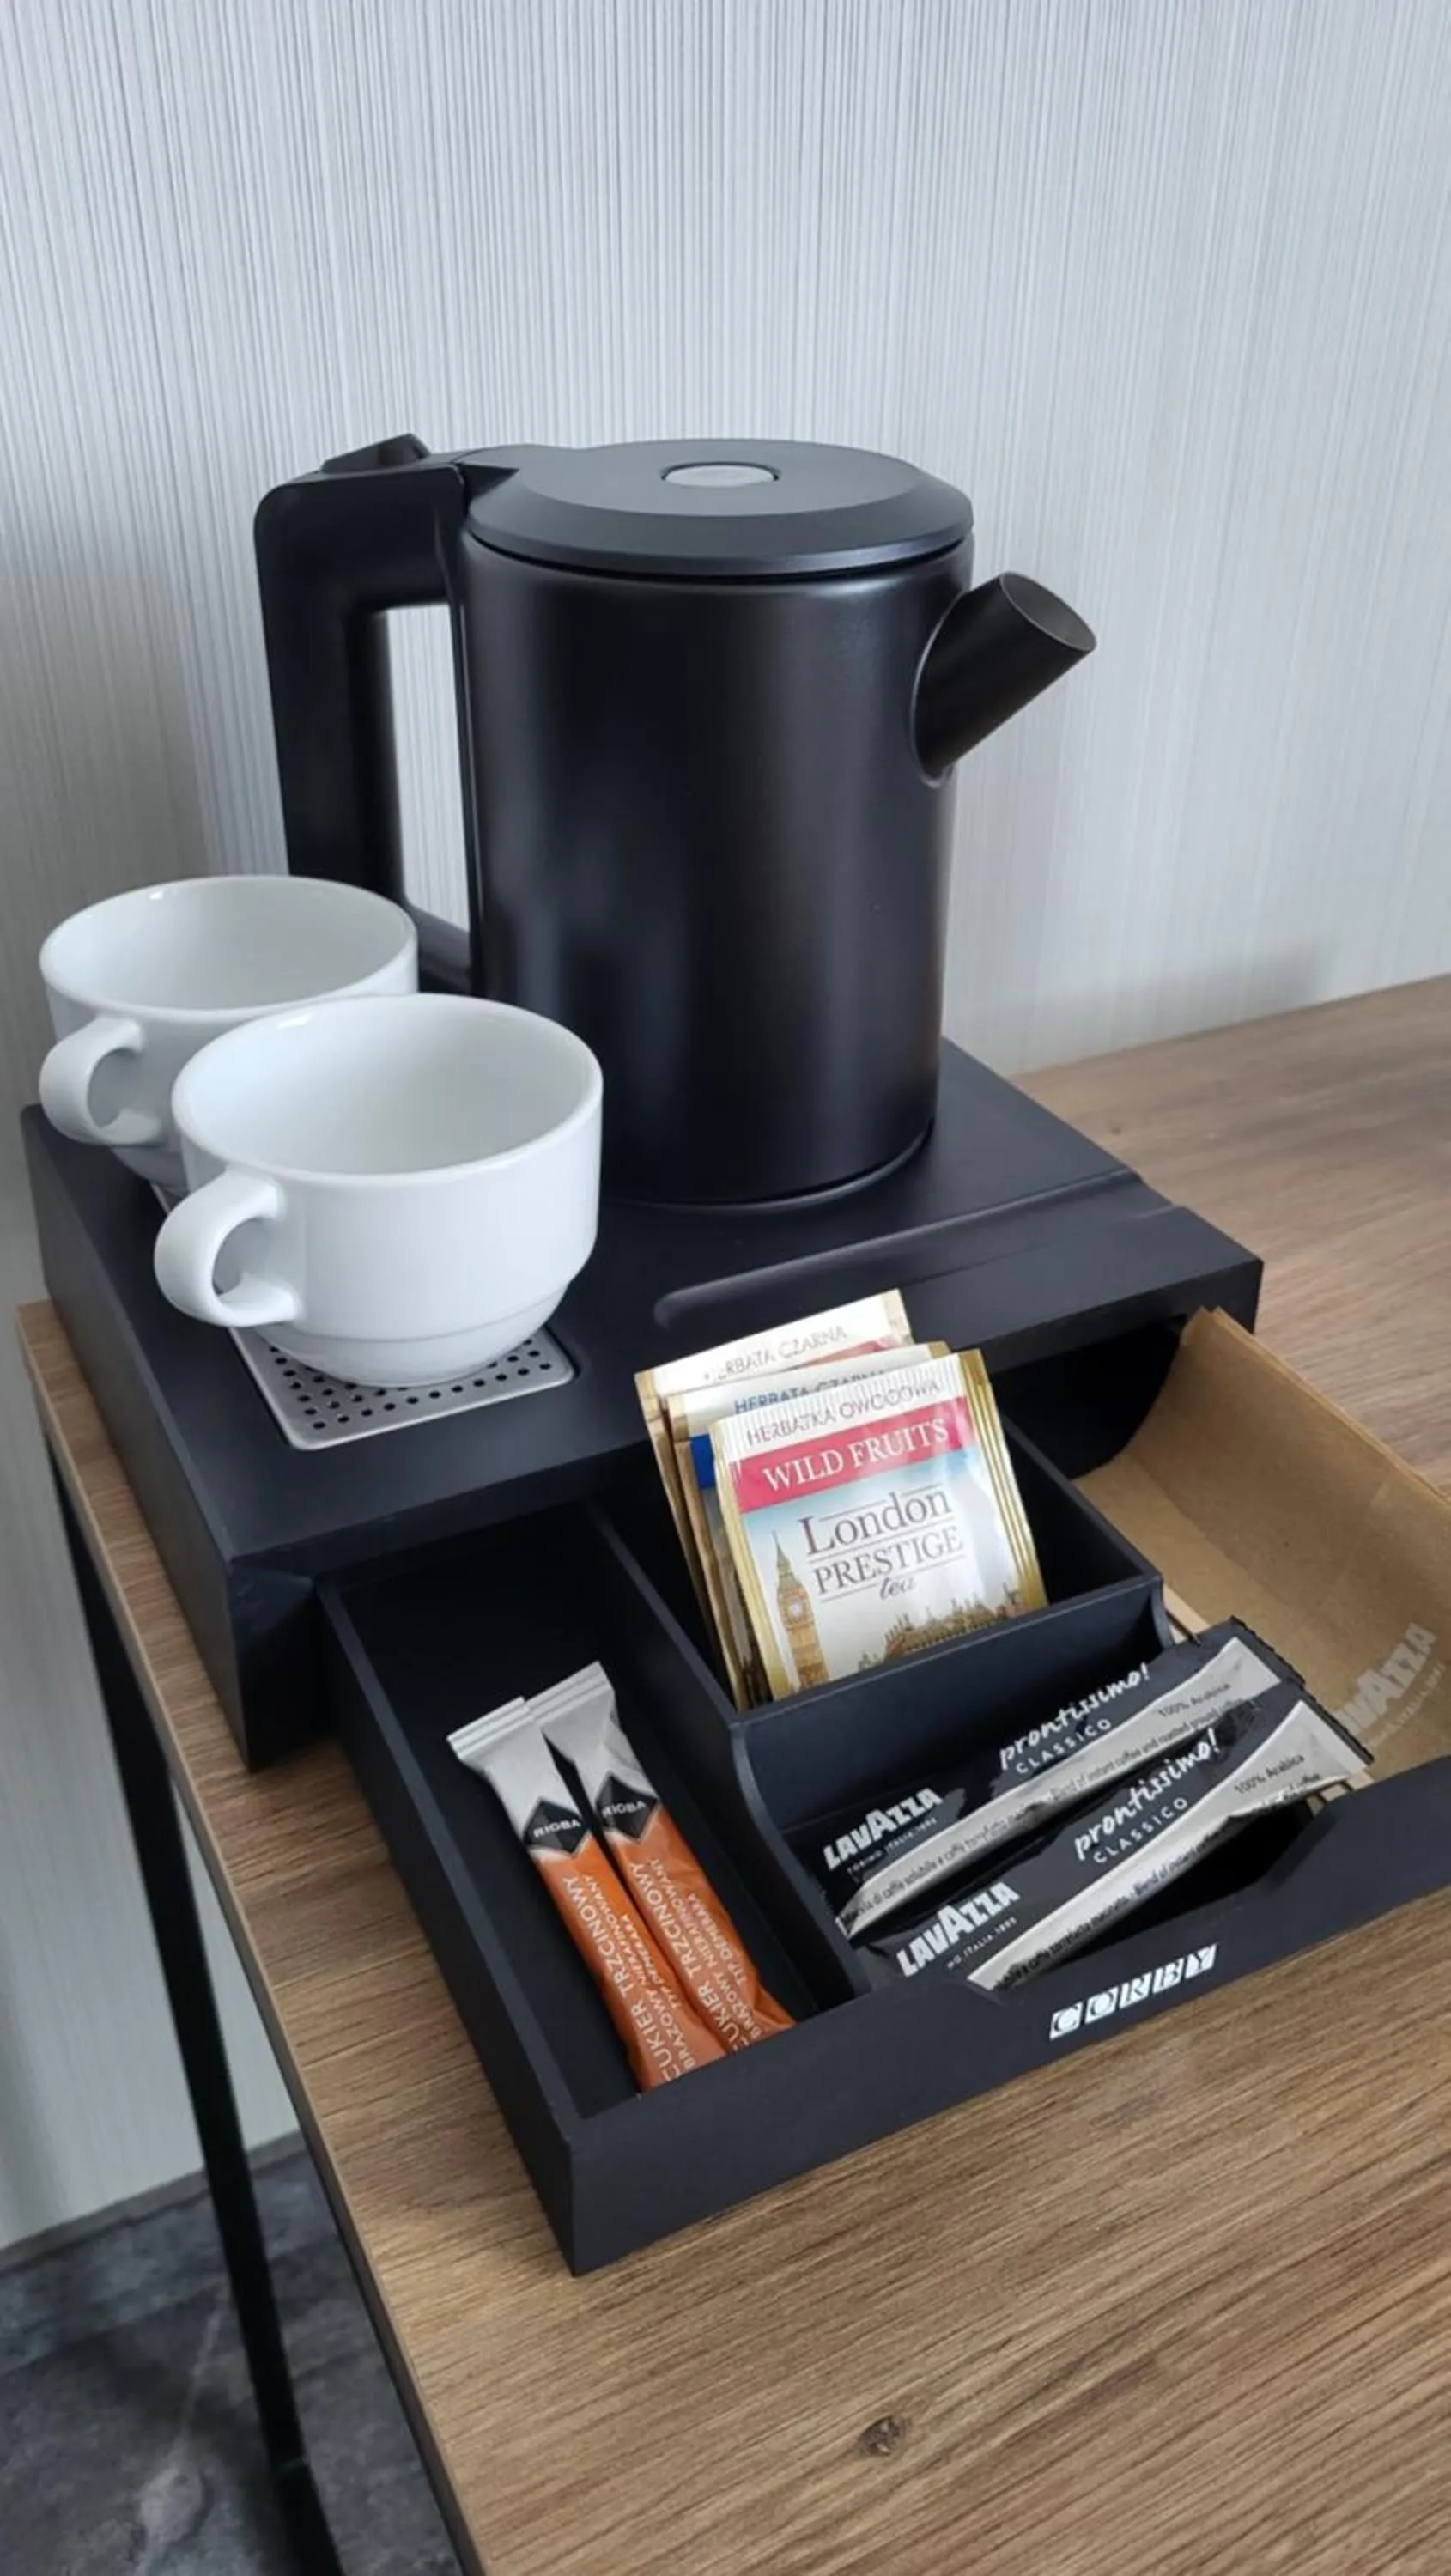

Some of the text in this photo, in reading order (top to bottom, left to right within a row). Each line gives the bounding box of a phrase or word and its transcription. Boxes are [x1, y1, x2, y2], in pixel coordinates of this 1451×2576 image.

[746, 1406, 836, 1446] HERBATKA
[762, 1417, 949, 1492] WILD FRUITS
[798, 1491, 953, 1555] London
[813, 1525, 964, 1595] PRESTIGE
[879, 1576, 916, 1601] tea
[999, 1662, 1150, 1771] prontissimo!
[1016, 1718, 1112, 1774] CLASSICO
[532, 1819, 581, 1838] RIOBA
[823, 1786, 944, 1872] LAVAZZA
[1074, 1728, 1221, 1861] prontissimo!
[1093, 1797, 1188, 1863] CLASSICO
[628, 1862, 701, 1979] TRZCINOWY
[895, 1881, 1021, 1978] LAVAZZA
[562, 1876, 681, 2081] CUKIER TRZCINOWY
[1048, 1941, 1219, 2042] CORBY
